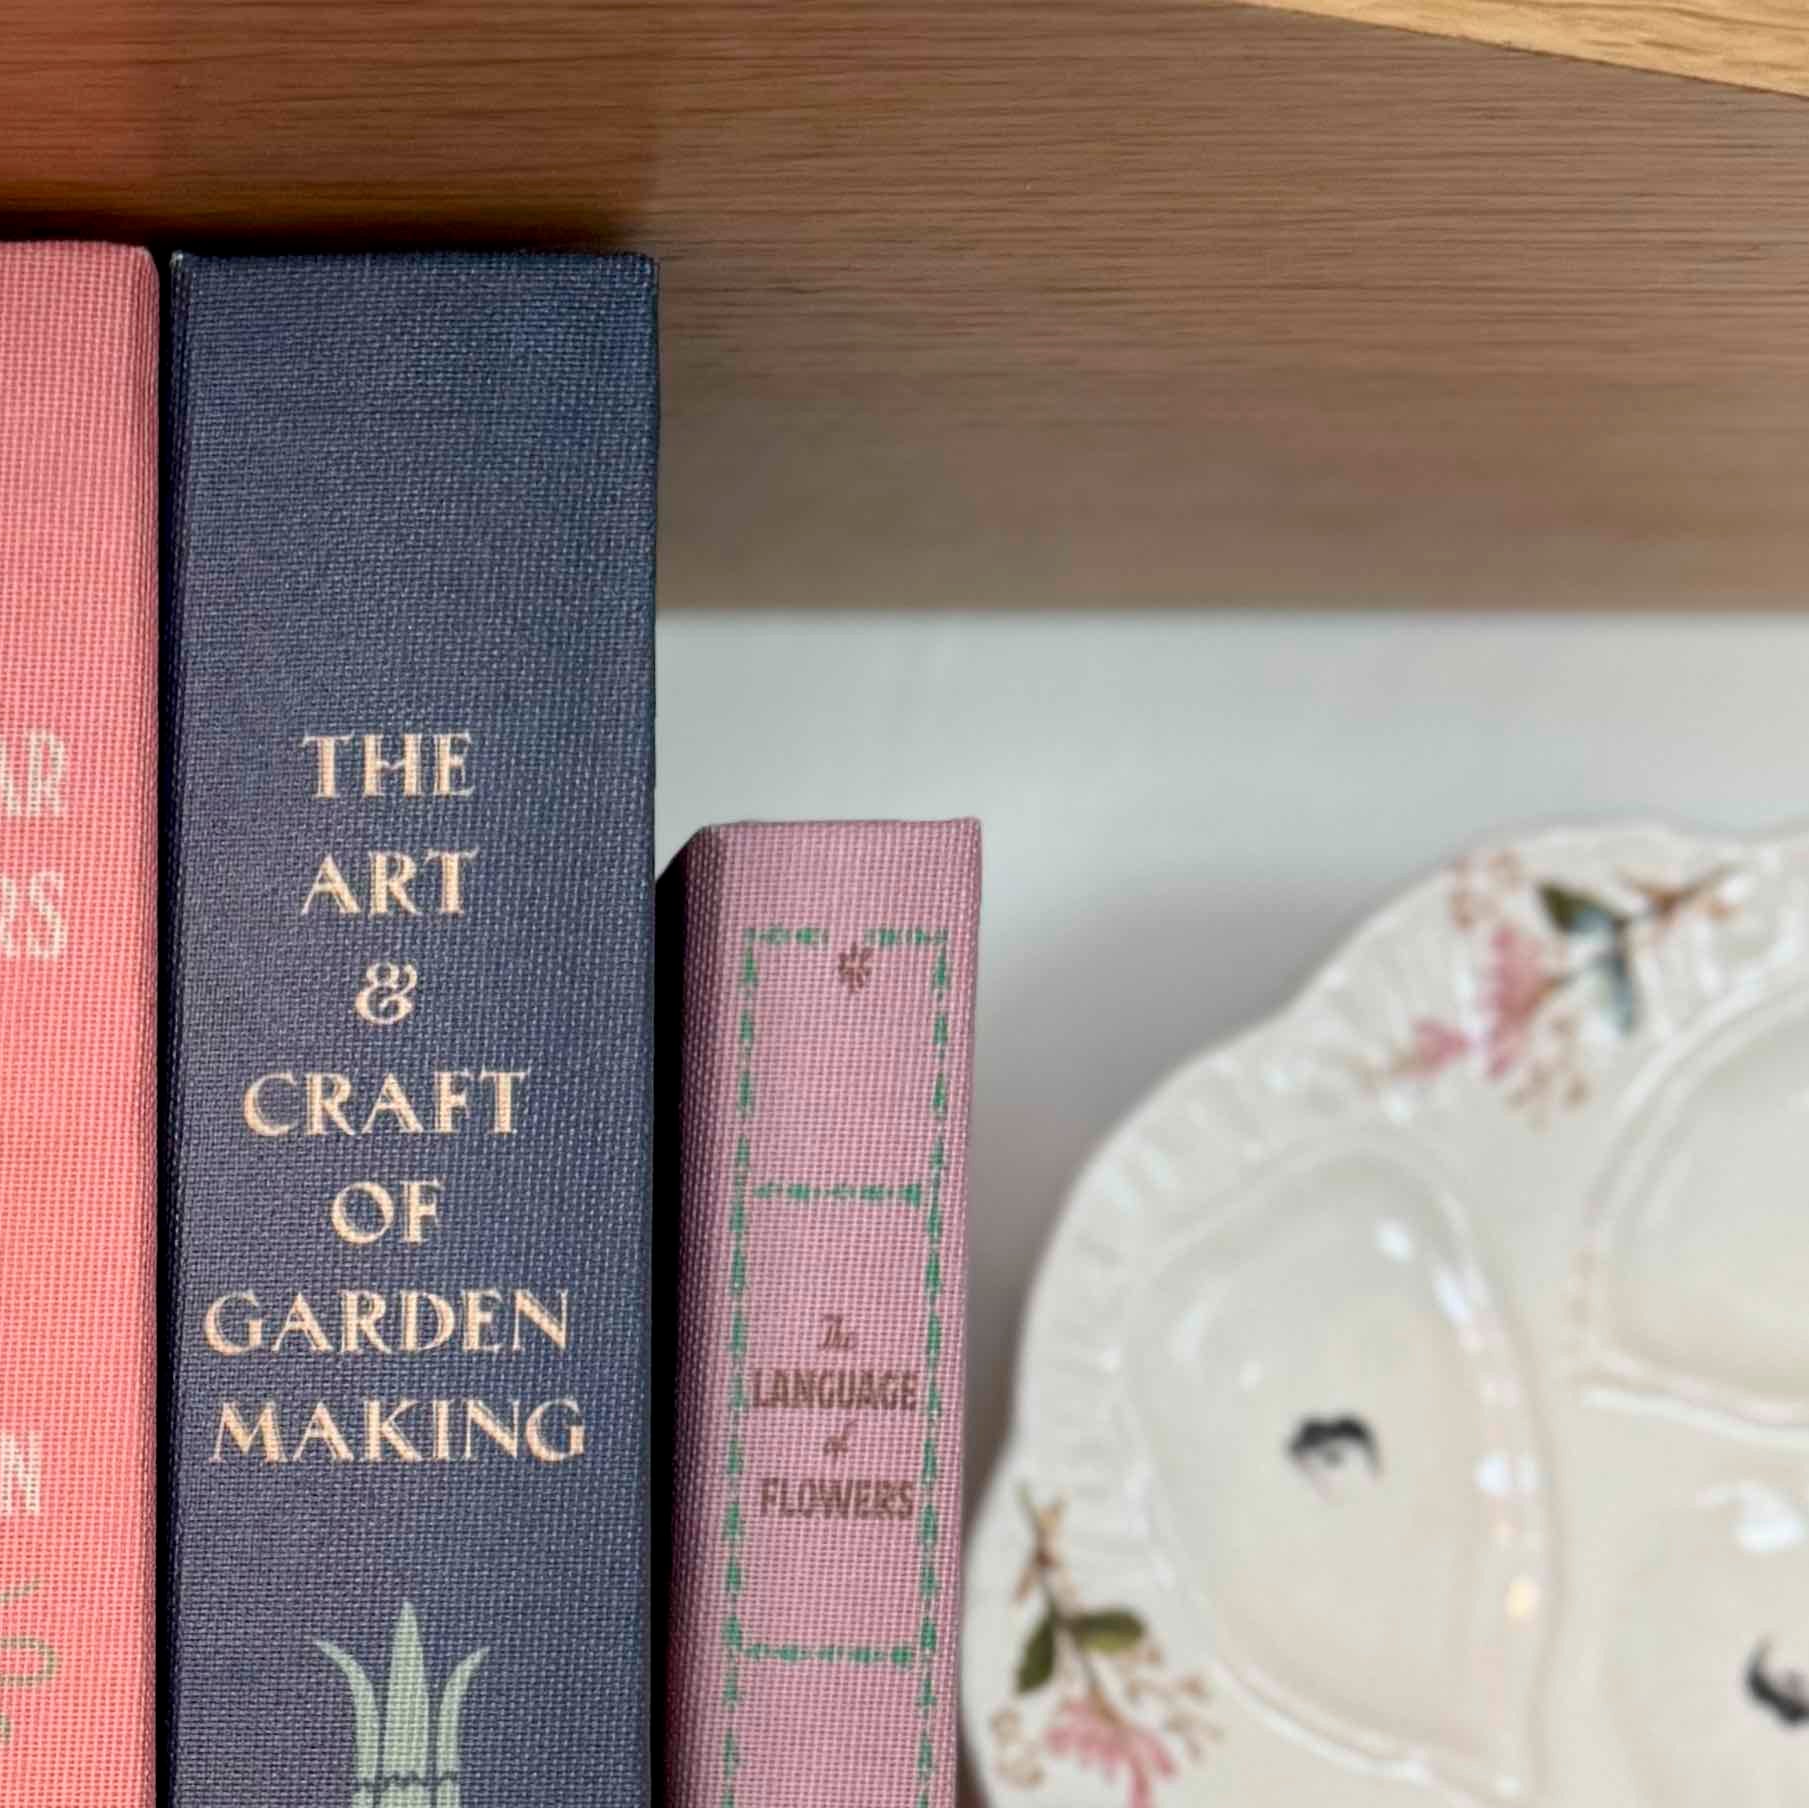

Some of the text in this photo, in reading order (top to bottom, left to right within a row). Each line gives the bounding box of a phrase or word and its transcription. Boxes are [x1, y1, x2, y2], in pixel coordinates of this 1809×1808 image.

[302, 733, 477, 801] THE
[300, 847, 479, 916] ART
[355, 961, 419, 1025] &
[243, 1071, 527, 1137] CRAFT
[331, 1179, 445, 1245] OF
[204, 1289, 570, 1356] GARDEN
[816, 1314, 857, 1351] The
[751, 1368, 918, 1410] LANGUAGE
[208, 1400, 587, 1464] MAKING
[822, 1419, 858, 1461] of
[759, 1478, 914, 1520] FLOWERS
